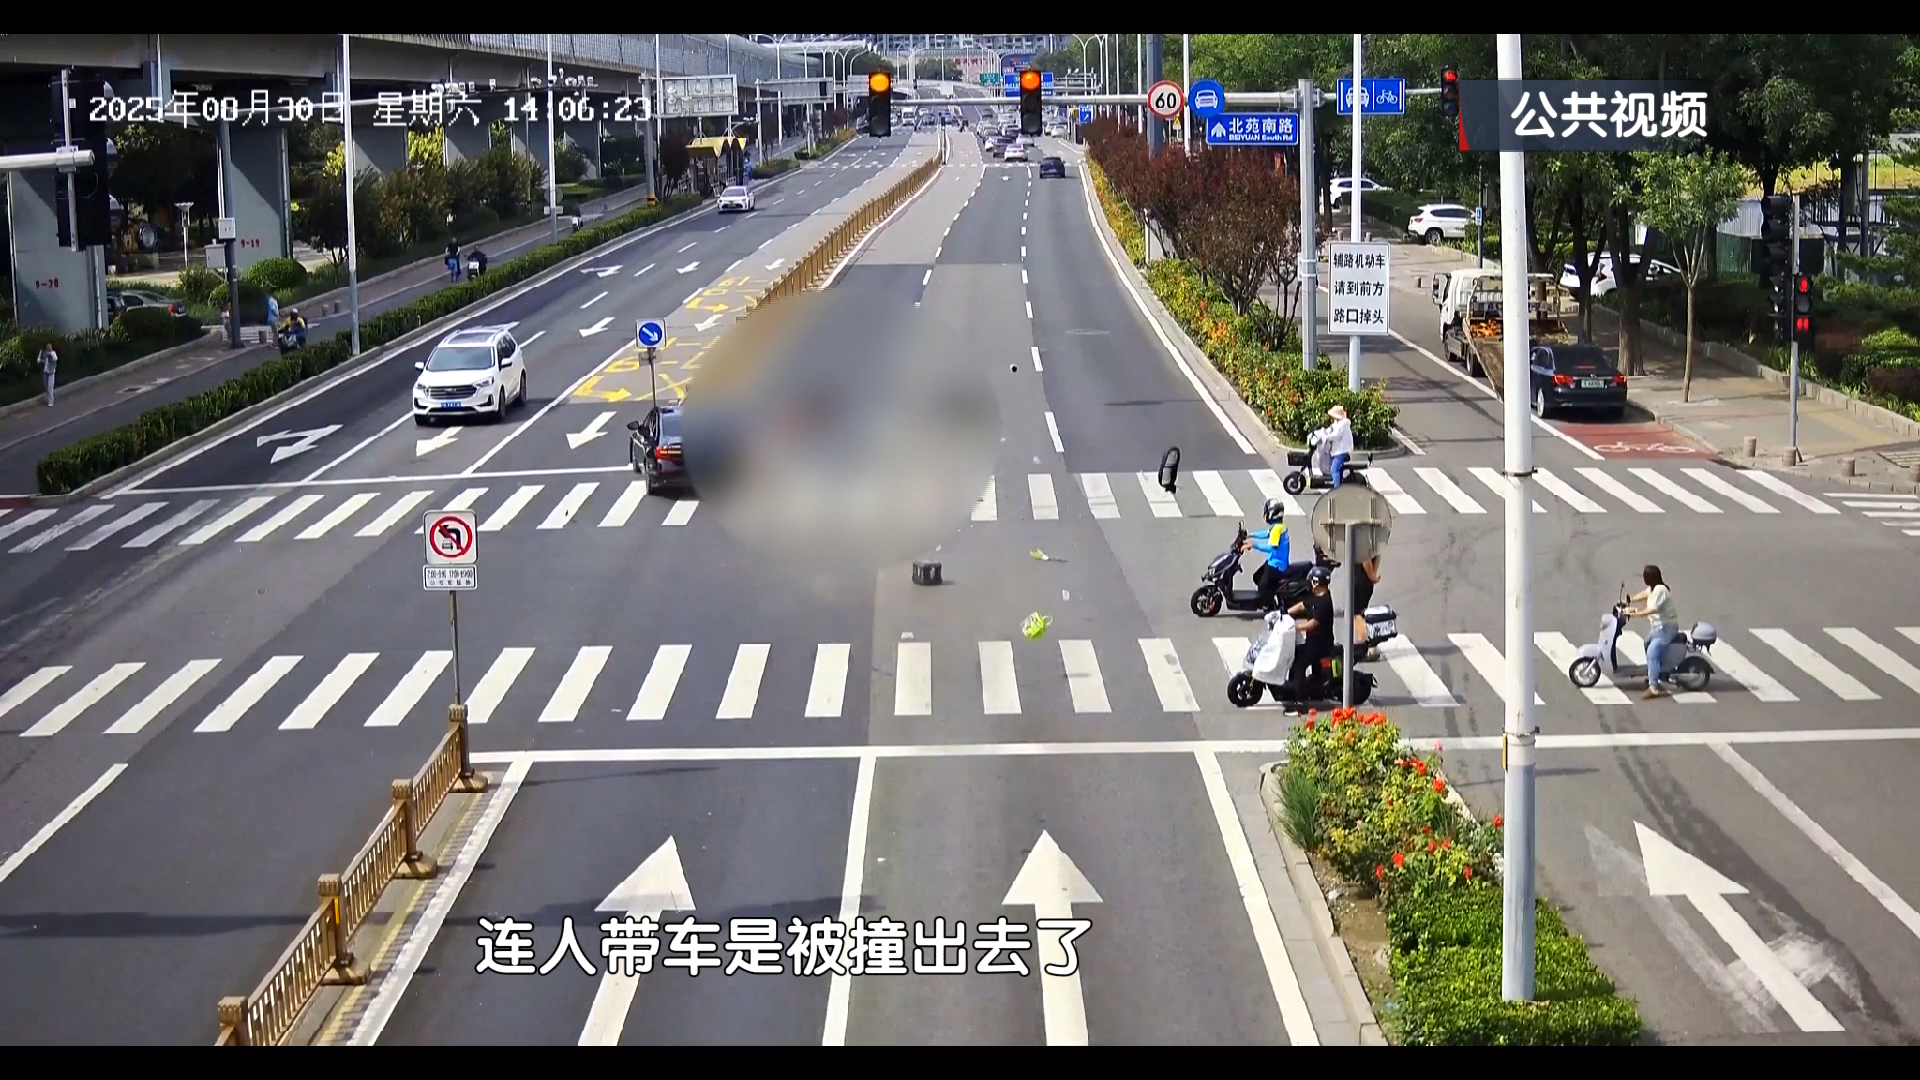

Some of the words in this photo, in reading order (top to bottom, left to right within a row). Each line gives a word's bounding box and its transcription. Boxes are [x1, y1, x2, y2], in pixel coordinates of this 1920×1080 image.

[1155, 92, 1177, 109] 60
[1228, 117, 1294, 134] 北苑南路
[1333, 252, 1386, 269] 辅路机动车
[1333, 280, 1385, 296] 请到前方
[1333, 308, 1385, 324] 路口掉头
